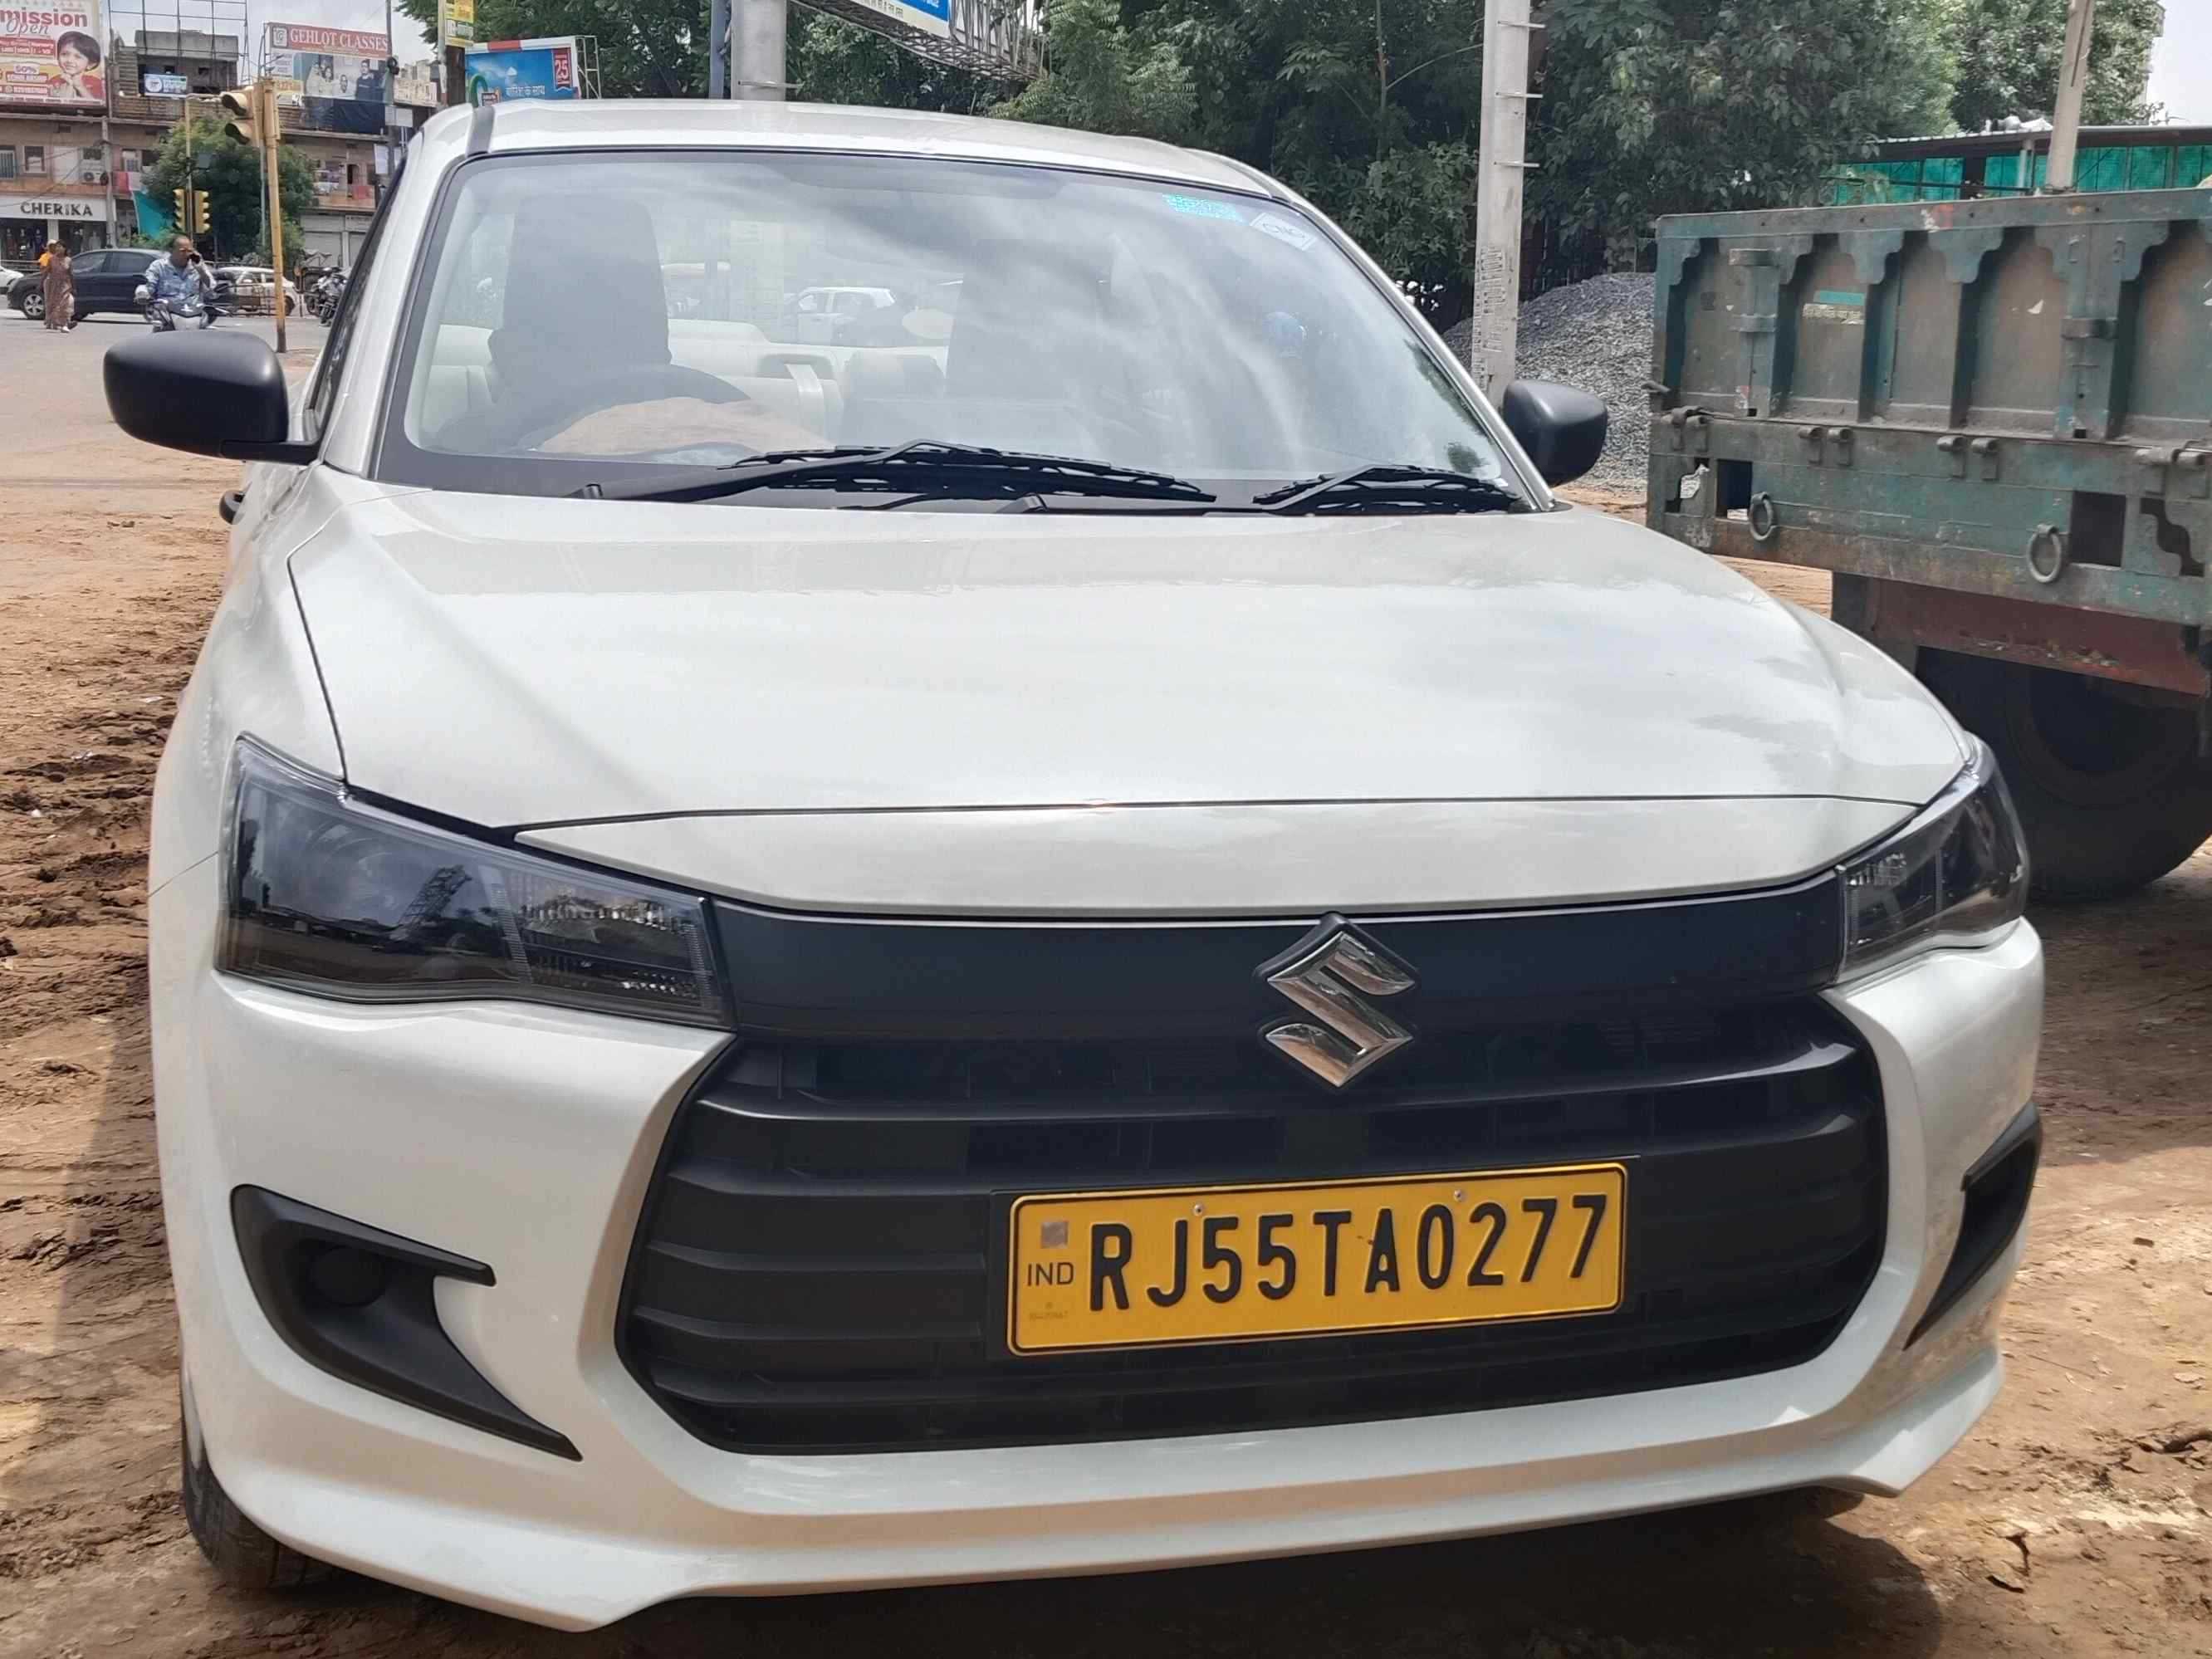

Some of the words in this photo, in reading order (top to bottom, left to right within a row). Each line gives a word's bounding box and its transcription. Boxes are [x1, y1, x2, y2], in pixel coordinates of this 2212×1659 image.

[0, 7, 87, 27] mission
[7, 17, 49, 36] Open
[291, 27, 337, 46] GEHLOT
[339, 32, 388, 51] CLASSES
[1027, 1261, 1074, 1286] IND
[1089, 1194, 1608, 1312] RJ55TA0277
